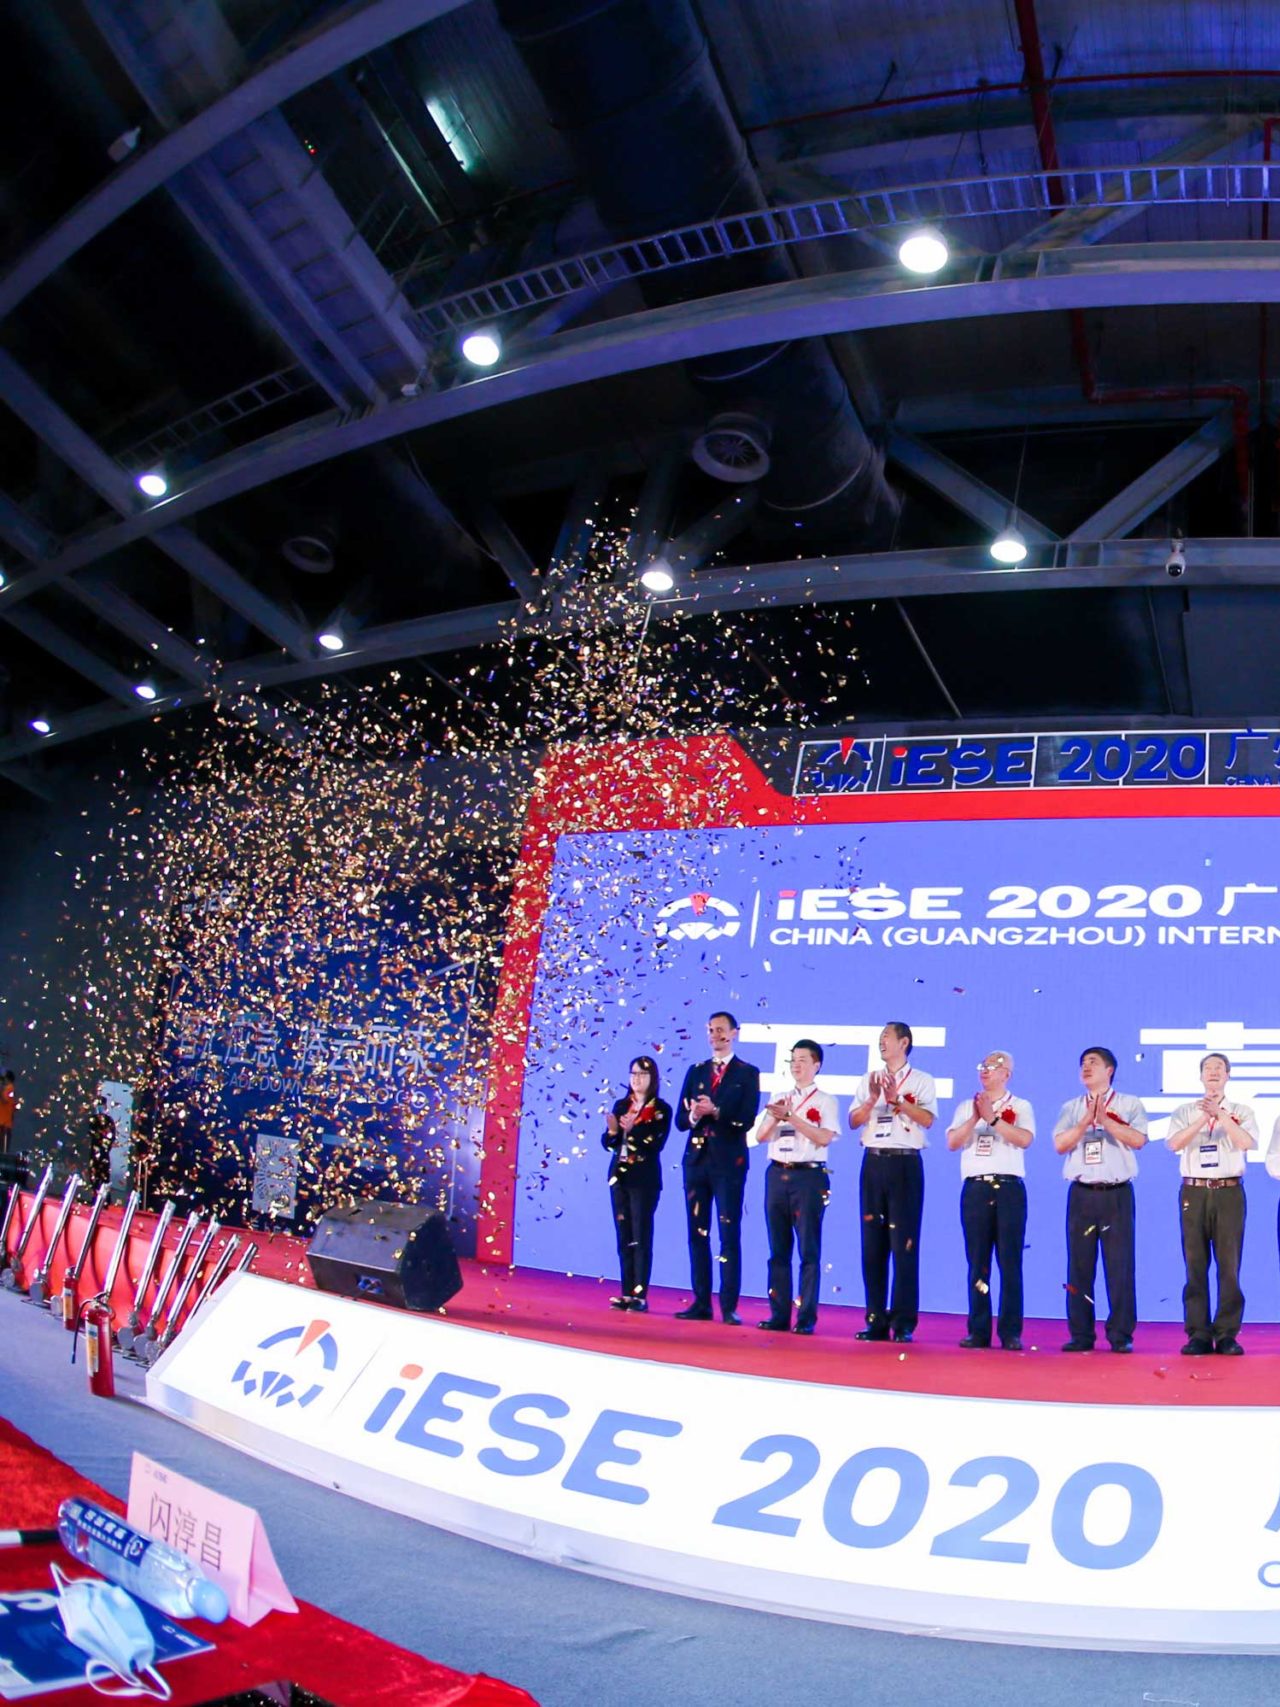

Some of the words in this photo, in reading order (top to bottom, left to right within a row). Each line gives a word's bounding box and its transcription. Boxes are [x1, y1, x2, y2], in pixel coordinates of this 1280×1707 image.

[889, 743, 1036, 785] iESE
[1057, 736, 1207, 783] 2020
[776, 886, 964, 921] iESE
[986, 884, 1203, 919] 2020
[769, 927, 873, 945] CHINA
[882, 925, 1146, 947] (GUANGZHOU)
[363, 1363, 683, 1505] iESE
[711, 1433, 1164, 1570] 2020
[149, 1491, 222, 1571] 闪淳昌
